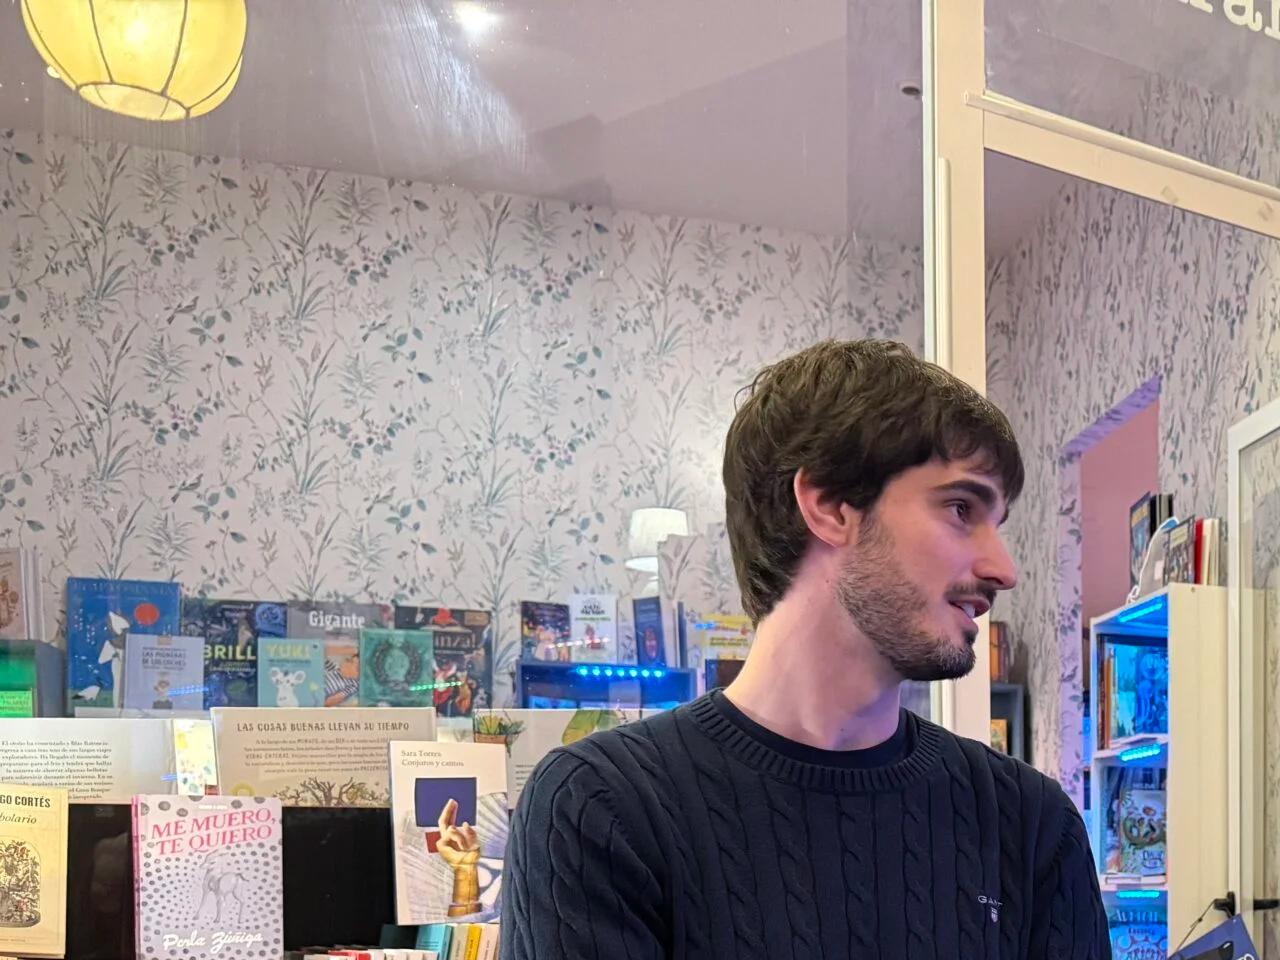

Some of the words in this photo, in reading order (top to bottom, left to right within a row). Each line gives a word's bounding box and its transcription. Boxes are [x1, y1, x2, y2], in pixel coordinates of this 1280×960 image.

[309, 610, 366, 630] Gigante
[238, 722, 254, 732] LAS
[257, 722, 287, 732] COSAS
[290, 722, 325, 732] BUENAS
[328, 722, 361, 731] LLEVAN
[364, 722, 374, 730] SU
[377, 722, 409, 730] TIEMPO
[401, 750, 416, 758] Sara
[418, 750, 442, 758] Torres
[402, 759, 432, 768] Conjuros
[14, 795, 51, 808] CORTÉS
[0, 813, 37, 825] bolario
[152, 821, 187, 839] ME
[156, 837, 184, 856] TE
[188, 825, 273, 853] QUIERO
[162, 930, 207, 950] Perla
